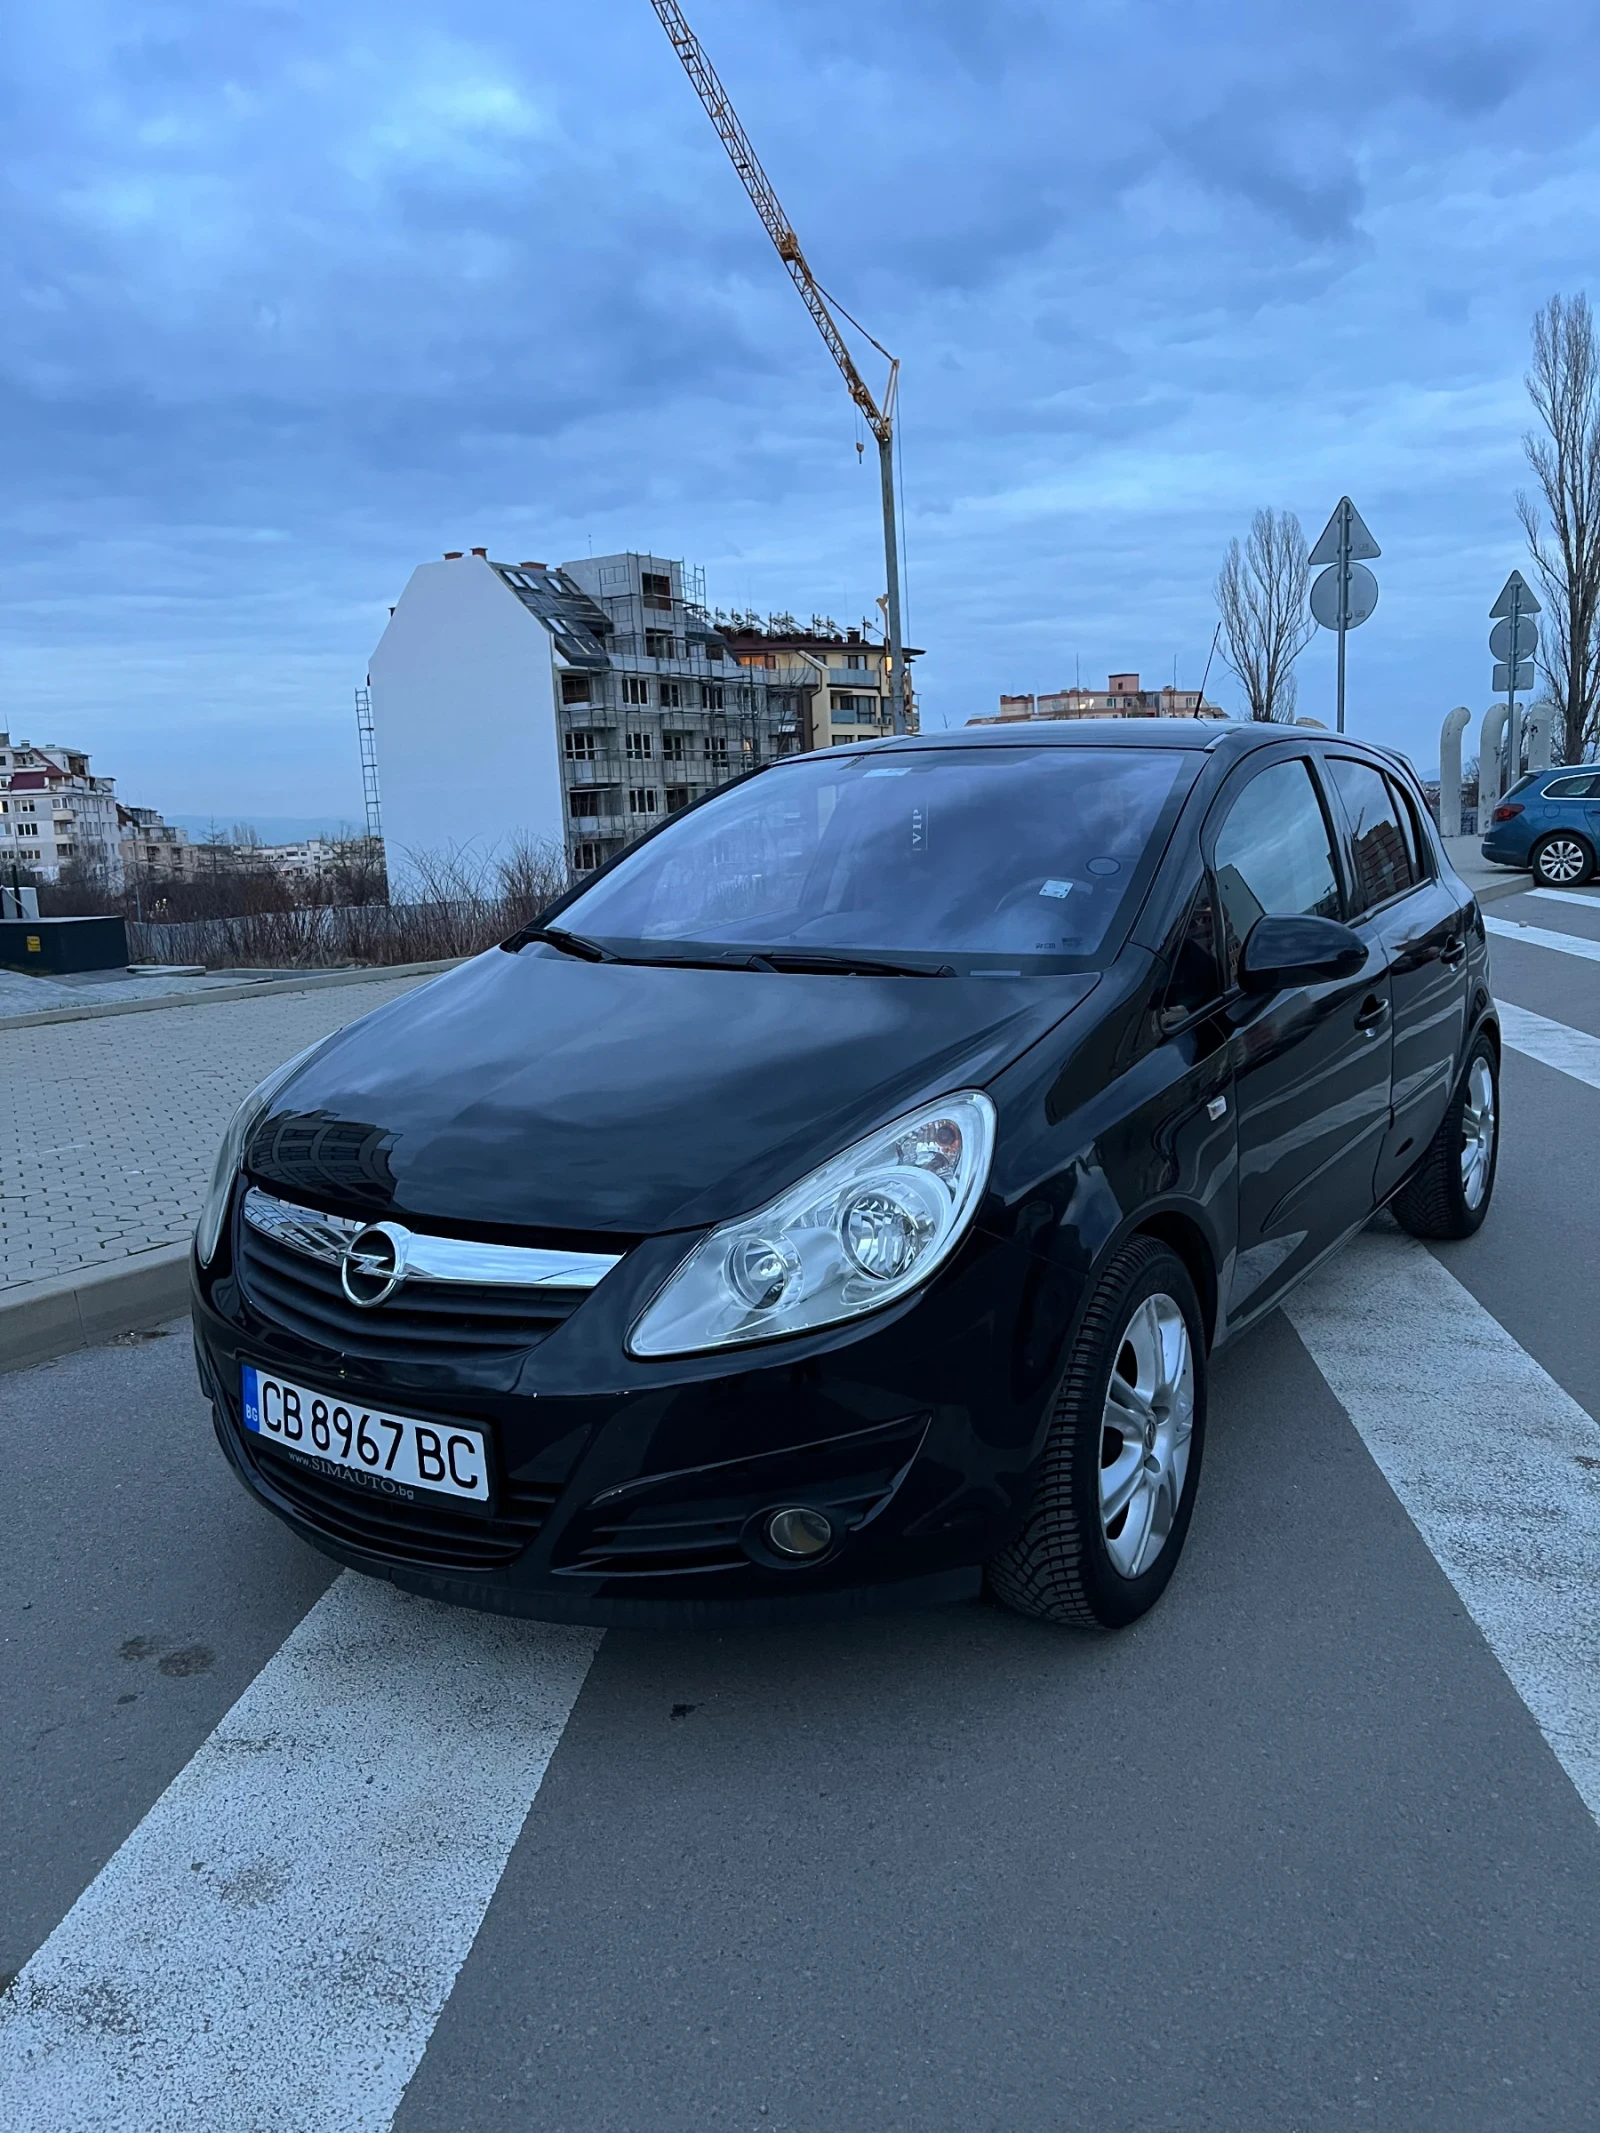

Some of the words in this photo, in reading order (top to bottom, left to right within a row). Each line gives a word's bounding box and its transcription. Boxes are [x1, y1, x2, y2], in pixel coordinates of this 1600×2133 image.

[245, 1403, 258, 1422] BG
[262, 1380, 303, 1441] CB
[311, 1399, 404, 1471] 8967
[415, 1426, 478, 1490] BC
[288, 1451, 414, 1500] www.SIMAUTO.bg
